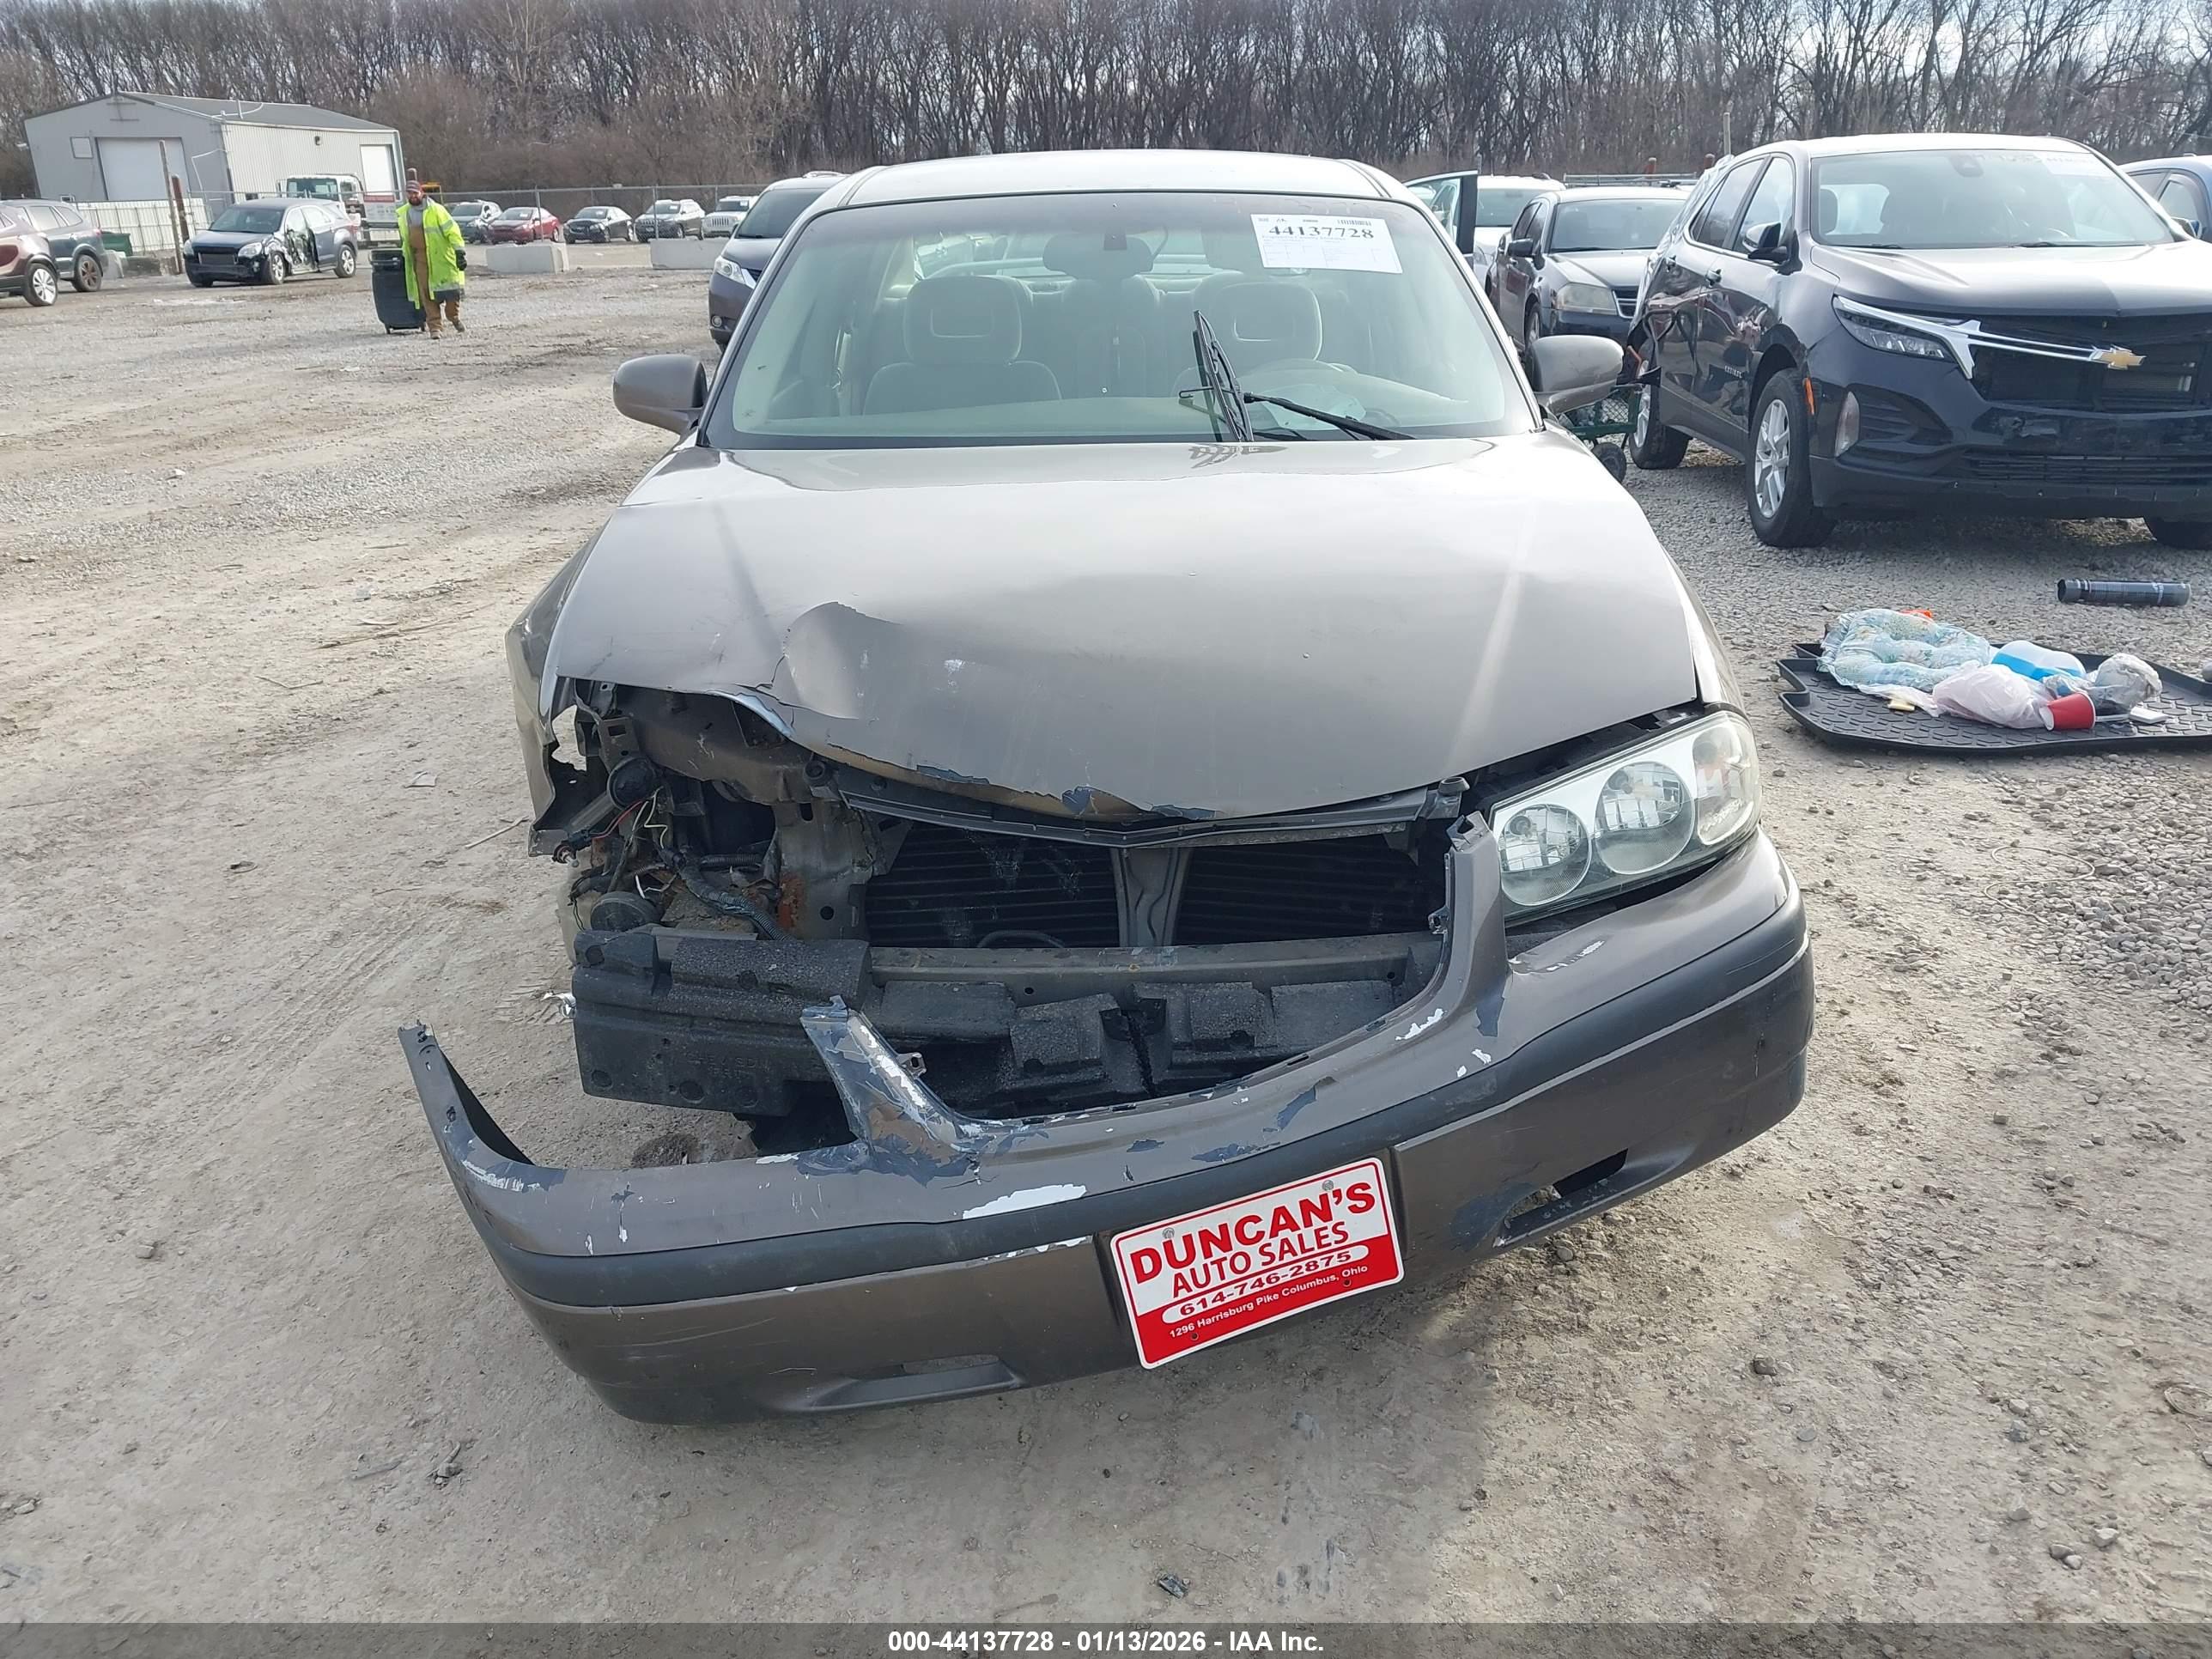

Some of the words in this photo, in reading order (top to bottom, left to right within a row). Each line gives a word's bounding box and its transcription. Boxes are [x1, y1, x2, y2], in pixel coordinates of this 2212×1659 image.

[1269, 225, 1375, 240] 44137728
[1130, 1182, 1375, 1285] DUNCAN'S
[1173, 1251, 1251, 1299] AUTO
[1259, 1221, 1349, 1267] SALES
[1170, 1323, 1194, 1338] 1296
[1197, 1302, 1255, 1328] Harrisburg
[1256, 1293, 1279, 1306] Pike
[1282, 1273, 1340, 1297] Columbus,
[1341, 1265, 1368, 1278] Ohio
[1180, 1250, 1352, 1316] 614-746-2875
